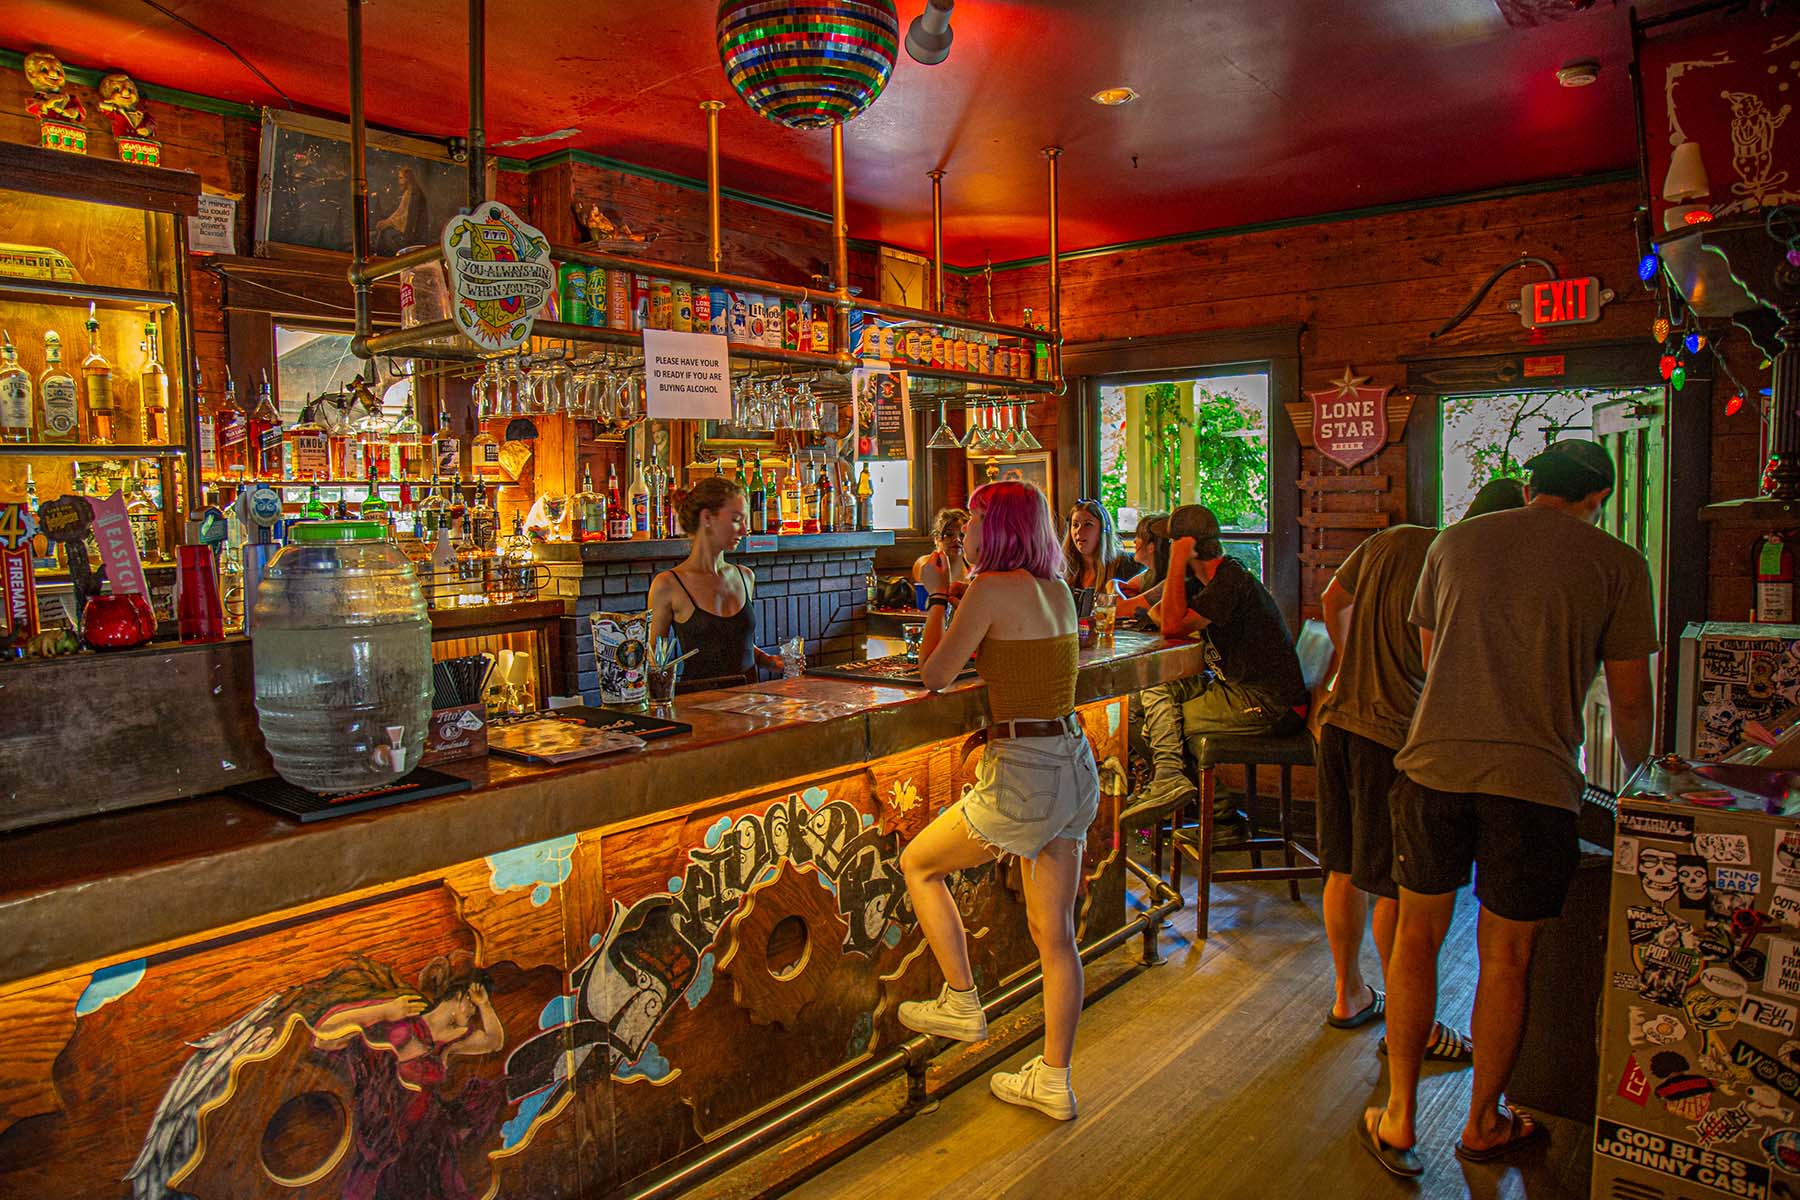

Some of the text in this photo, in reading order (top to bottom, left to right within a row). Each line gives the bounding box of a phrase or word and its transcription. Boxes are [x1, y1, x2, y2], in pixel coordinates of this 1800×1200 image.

[483, 229, 507, 240] 777
[463, 261, 484, 275] YOU
[486, 264, 530, 278] ALWAYS
[467, 284, 541, 297] WHEN YOU TIP
[1533, 278, 1591, 324] EXIT
[655, 356, 719, 368] PLEASE HAVE YOUR
[653, 369, 722, 381] ID READY IF YOU ARE
[659, 384, 719, 394] BUYING ALCOHOL
[1321, 401, 1375, 419] LONE
[1321, 421, 1376, 439] STAR
[1718, 869, 1759, 883] KING
[1717, 879, 1757, 892] BABY
[1616, 1127, 1666, 1153] GOD
[1669, 1142, 1748, 1178] BLESS
[1597, 1138, 1768, 1200] JOHNNY CASH
